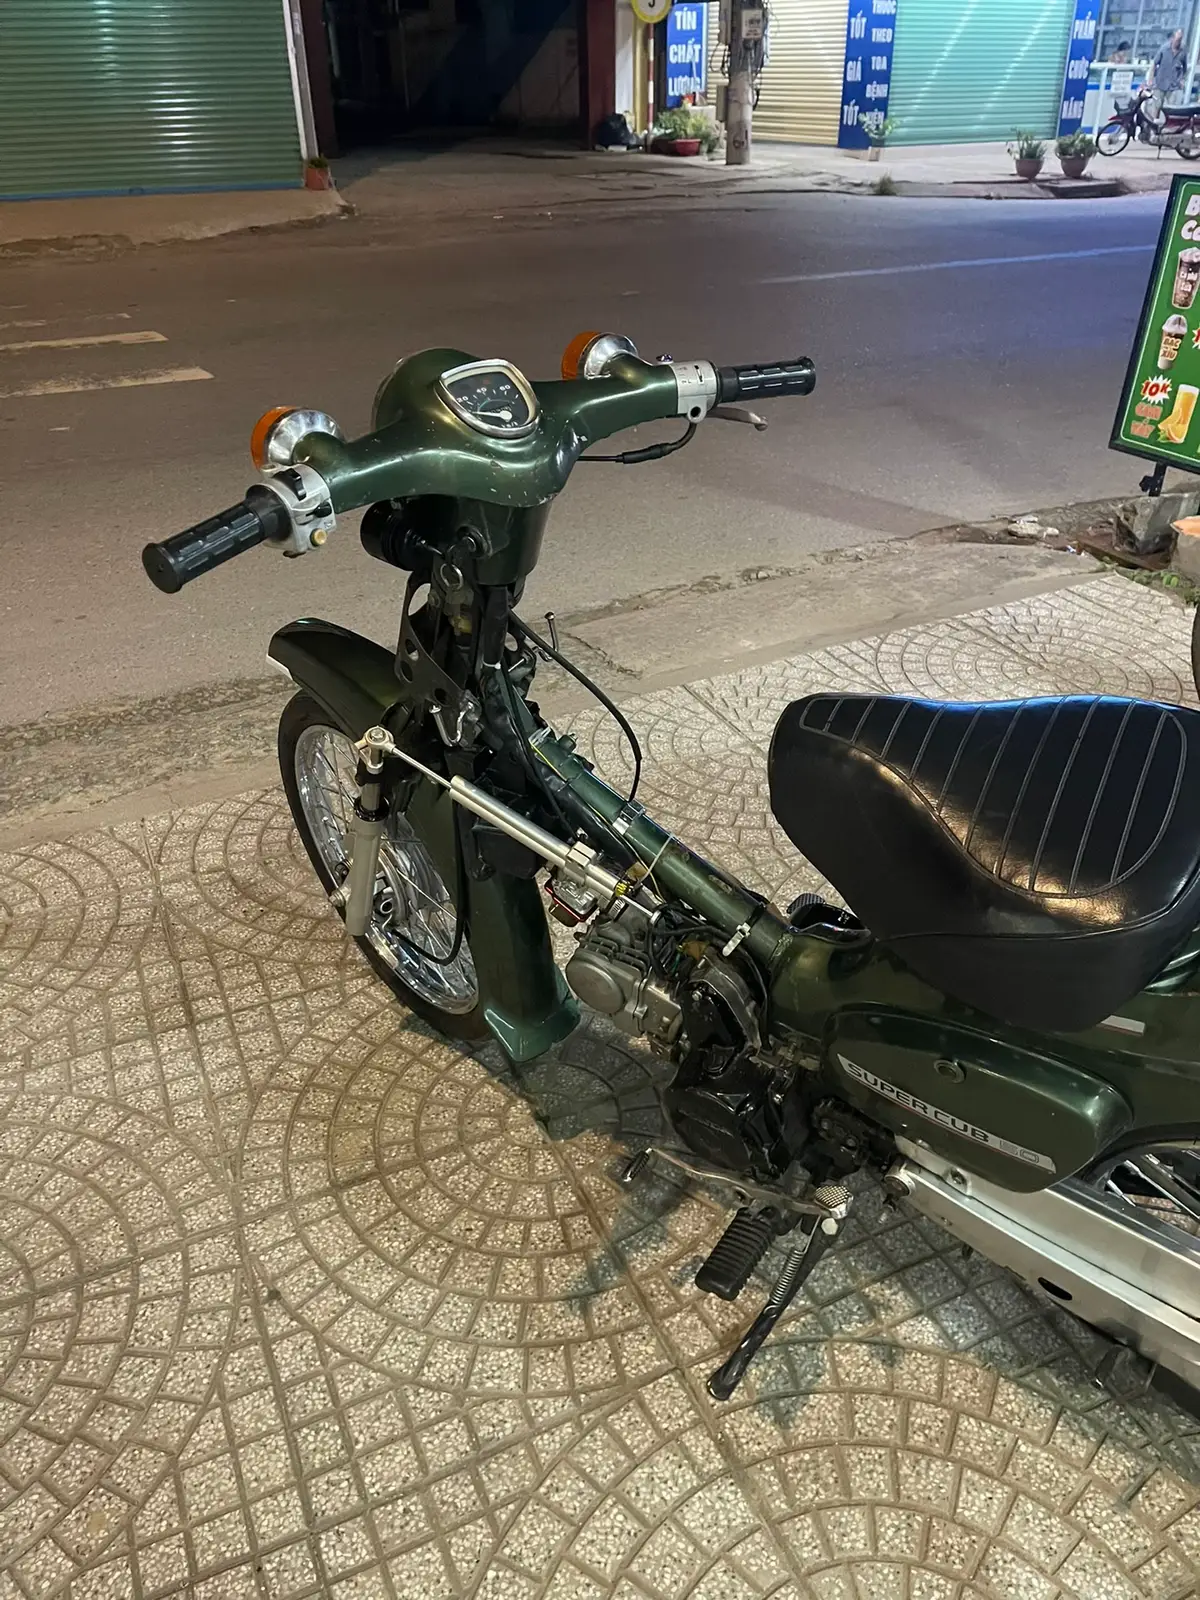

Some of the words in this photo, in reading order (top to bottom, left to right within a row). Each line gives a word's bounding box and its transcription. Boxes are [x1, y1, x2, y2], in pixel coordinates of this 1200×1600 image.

[675, 7, 697, 31] TÍN
[850, 9, 867, 39] TỐT
[871, 28, 893, 43] THEO
[669, 38, 701, 64] CHẤT
[871, 56, 887, 70] TOA
[846, 56, 862, 82] GIÁ
[843, 99, 859, 126] TỐT
[847, 1062, 929, 1115] SUPER
[934, 1109, 989, 1143] CUB
